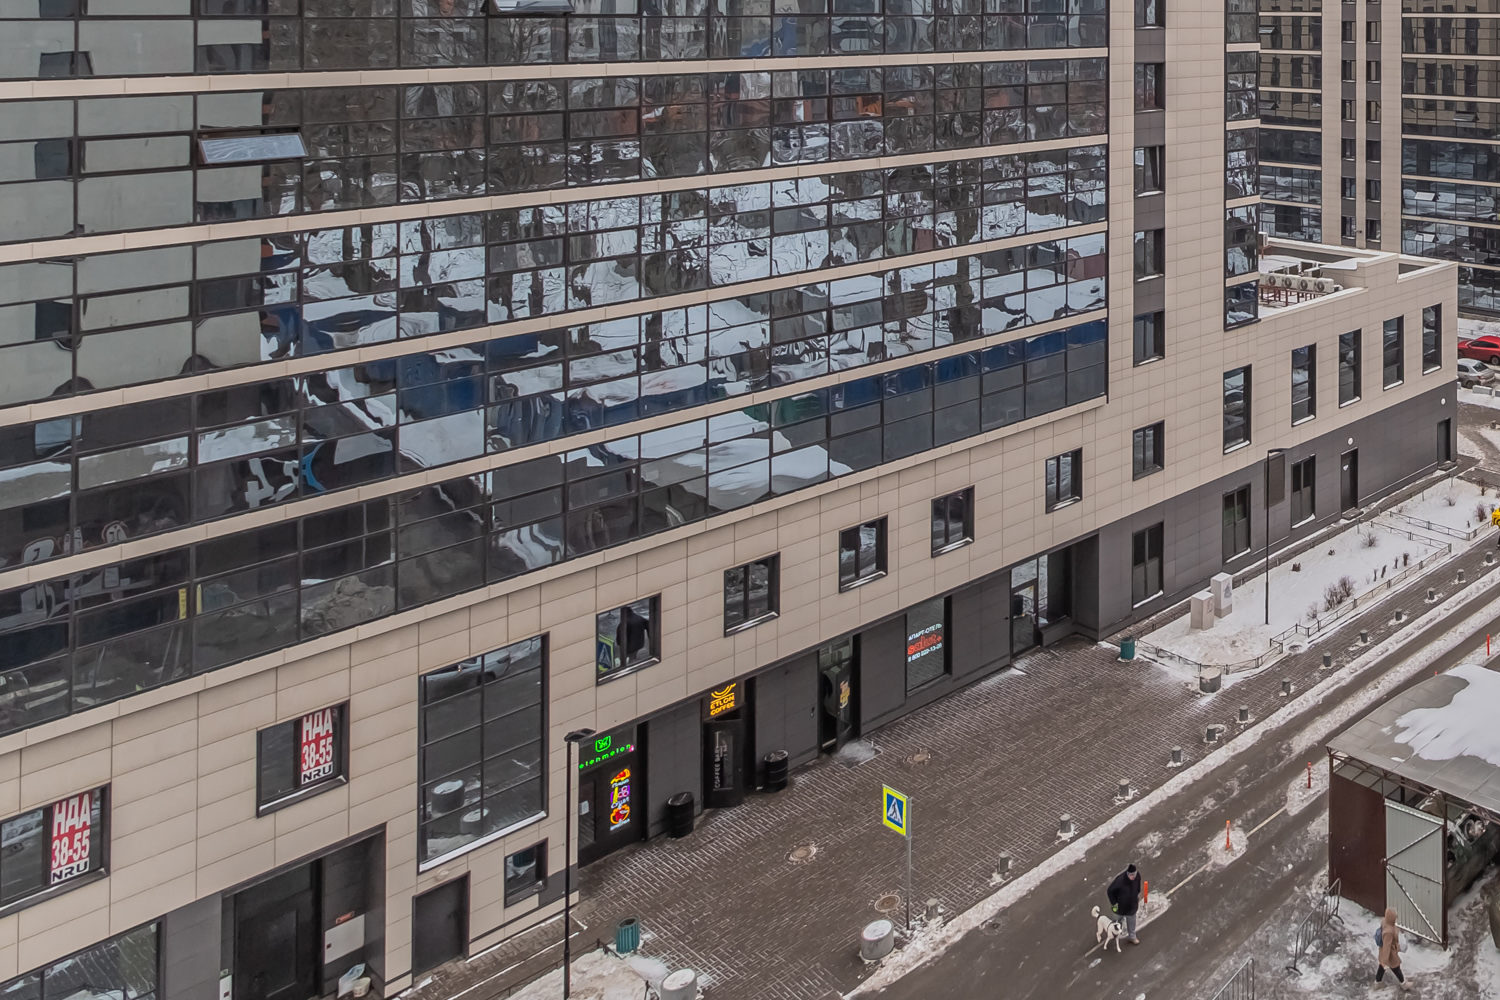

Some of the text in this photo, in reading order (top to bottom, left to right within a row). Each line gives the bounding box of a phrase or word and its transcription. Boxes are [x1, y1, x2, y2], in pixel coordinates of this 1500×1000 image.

[302, 736, 333, 771] 38-55
[302, 764, 333, 783] NRU
[52, 828, 91, 869] 38-55
[52, 860, 89, 882] NRU
